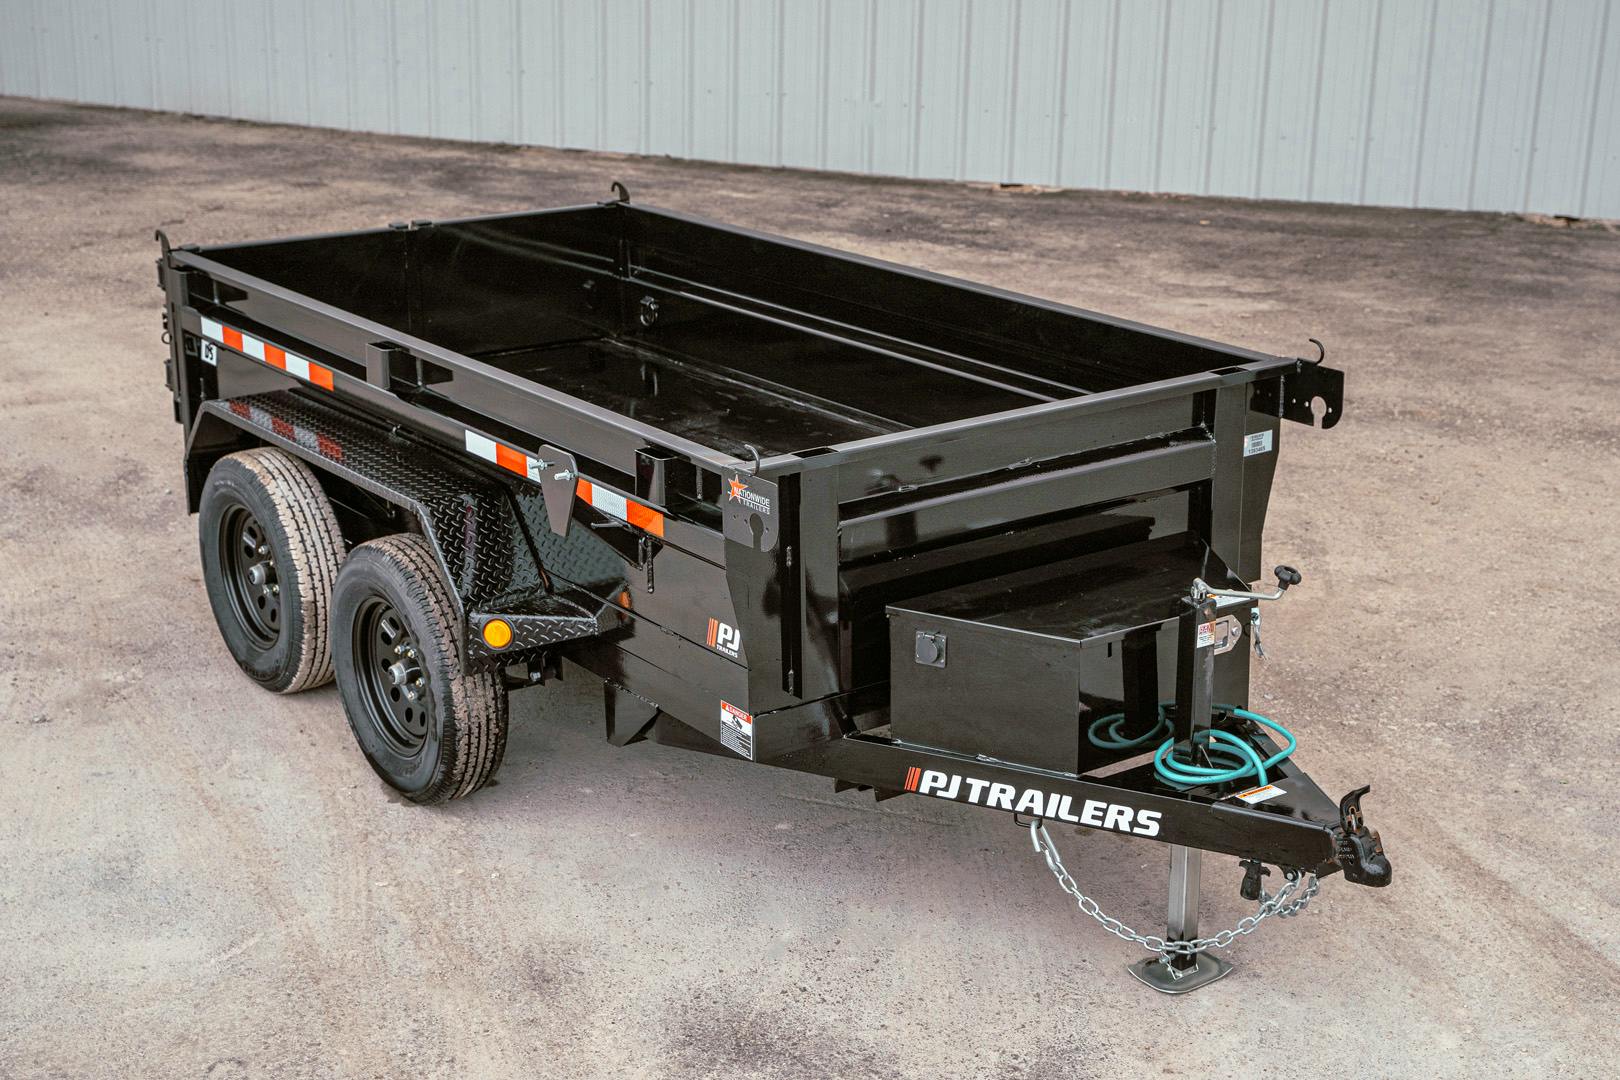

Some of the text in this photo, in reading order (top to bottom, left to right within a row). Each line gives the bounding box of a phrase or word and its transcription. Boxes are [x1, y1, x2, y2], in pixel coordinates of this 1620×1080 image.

[733, 487, 770, 507] NATIONWIDE
[717, 622, 740, 651] PJ
[919, 769, 1162, 837] PJ TRAILERS
